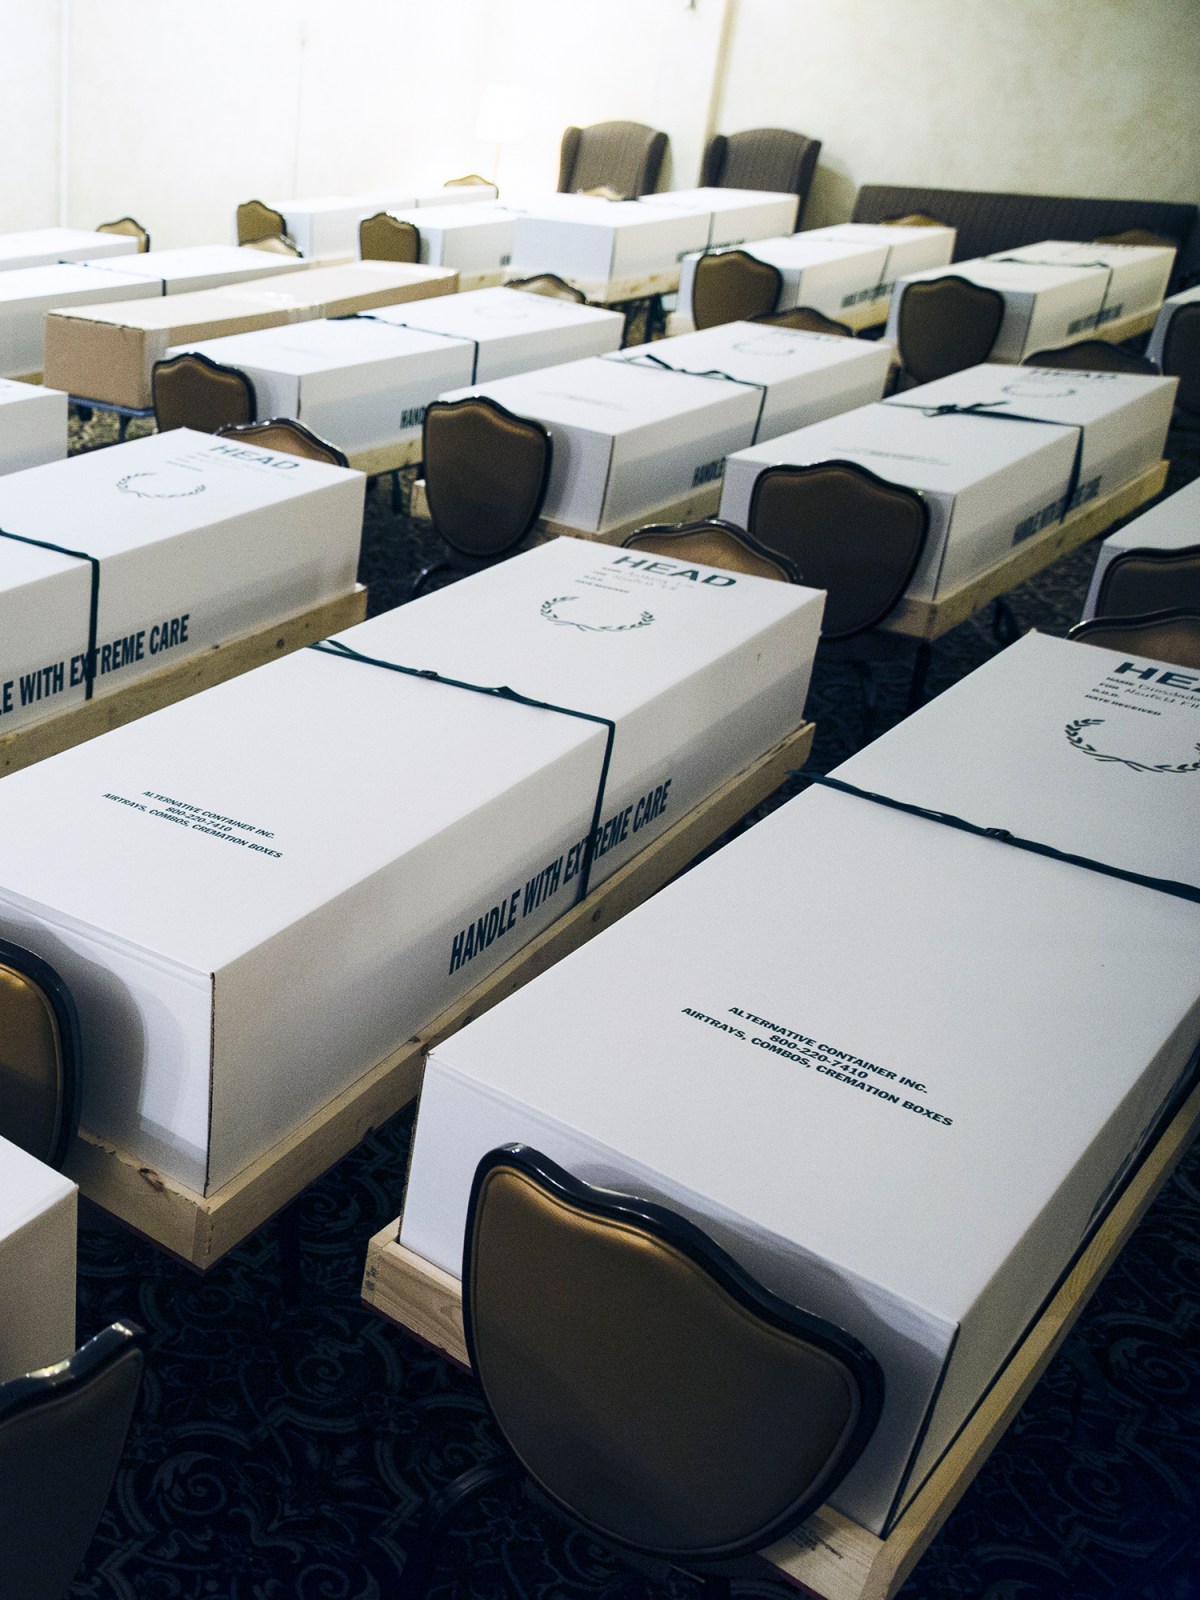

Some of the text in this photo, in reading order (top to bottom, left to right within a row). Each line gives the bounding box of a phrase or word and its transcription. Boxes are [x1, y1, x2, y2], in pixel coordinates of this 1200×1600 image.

[209, 445, 301, 470] HEAD
[612, 555, 737, 587] HEAD
[20, 662, 64, 707] WITH
[70, 630, 145, 688] EXREME
[149, 614, 190, 655] CARE
[102, 793, 283, 859] AIRTRAYS, COMBOS, CREMATION BOXES
[142, 791, 275, 839] ALTERNATIVE CONTAINER INC.
[165, 806, 233, 832] 800-220-7410
[449, 888, 521, 975] HANDLE
[522, 855, 564, 918] WITH
[632, 778, 672, 832] CARE
[681, 1007, 954, 1127] AIRTRAYS, COMBOS, CREMATION BOXES
[728, 1006, 928, 1094] ALTERNATIVE CONTAINER INC.
[769, 1034, 869, 1079] 800-220-7410
